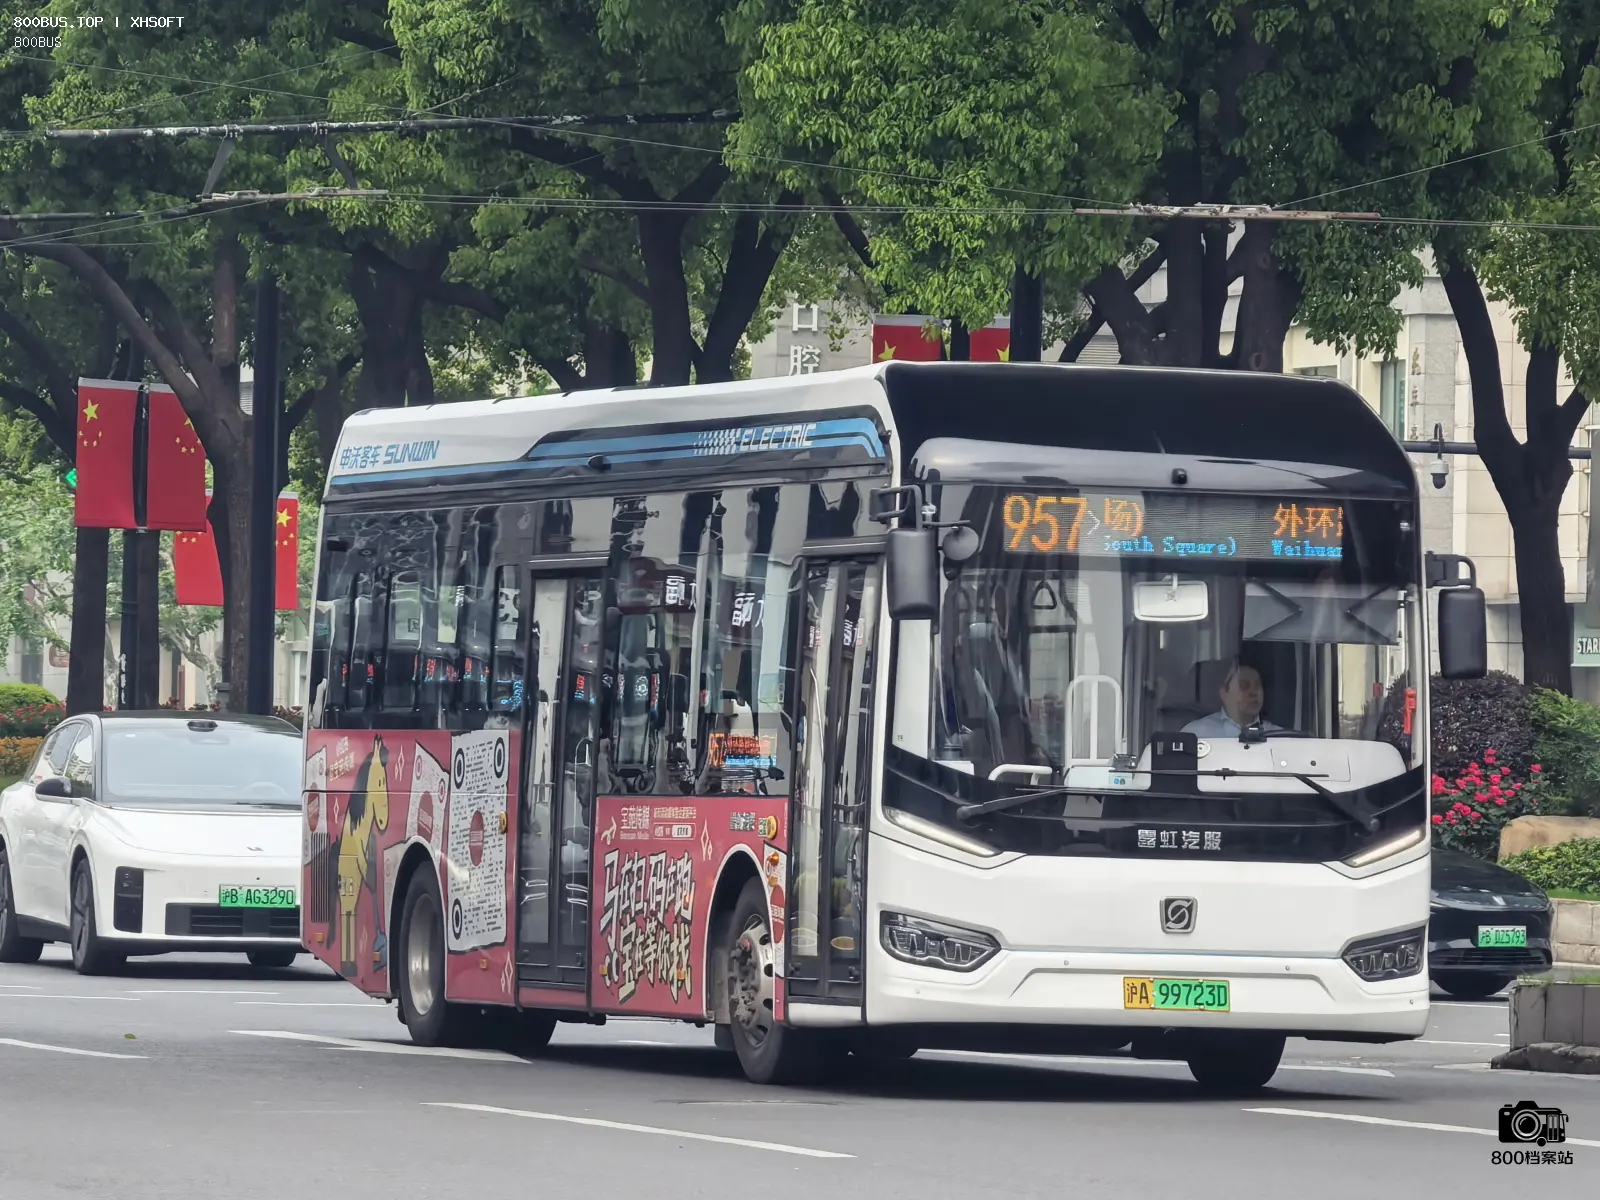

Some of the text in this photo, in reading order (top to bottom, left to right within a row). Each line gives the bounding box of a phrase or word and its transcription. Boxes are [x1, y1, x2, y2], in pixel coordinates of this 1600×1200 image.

[788, 302, 821, 377] 口腔
[740, 423, 817, 453] ELECTRIC
[340, 439, 441, 470] 申沃客车 SUNWIN
[1002, 495, 1088, 552] 957
[1162, 536, 1237, 557] Square)
[1577, 637, 1600, 654] STAR
